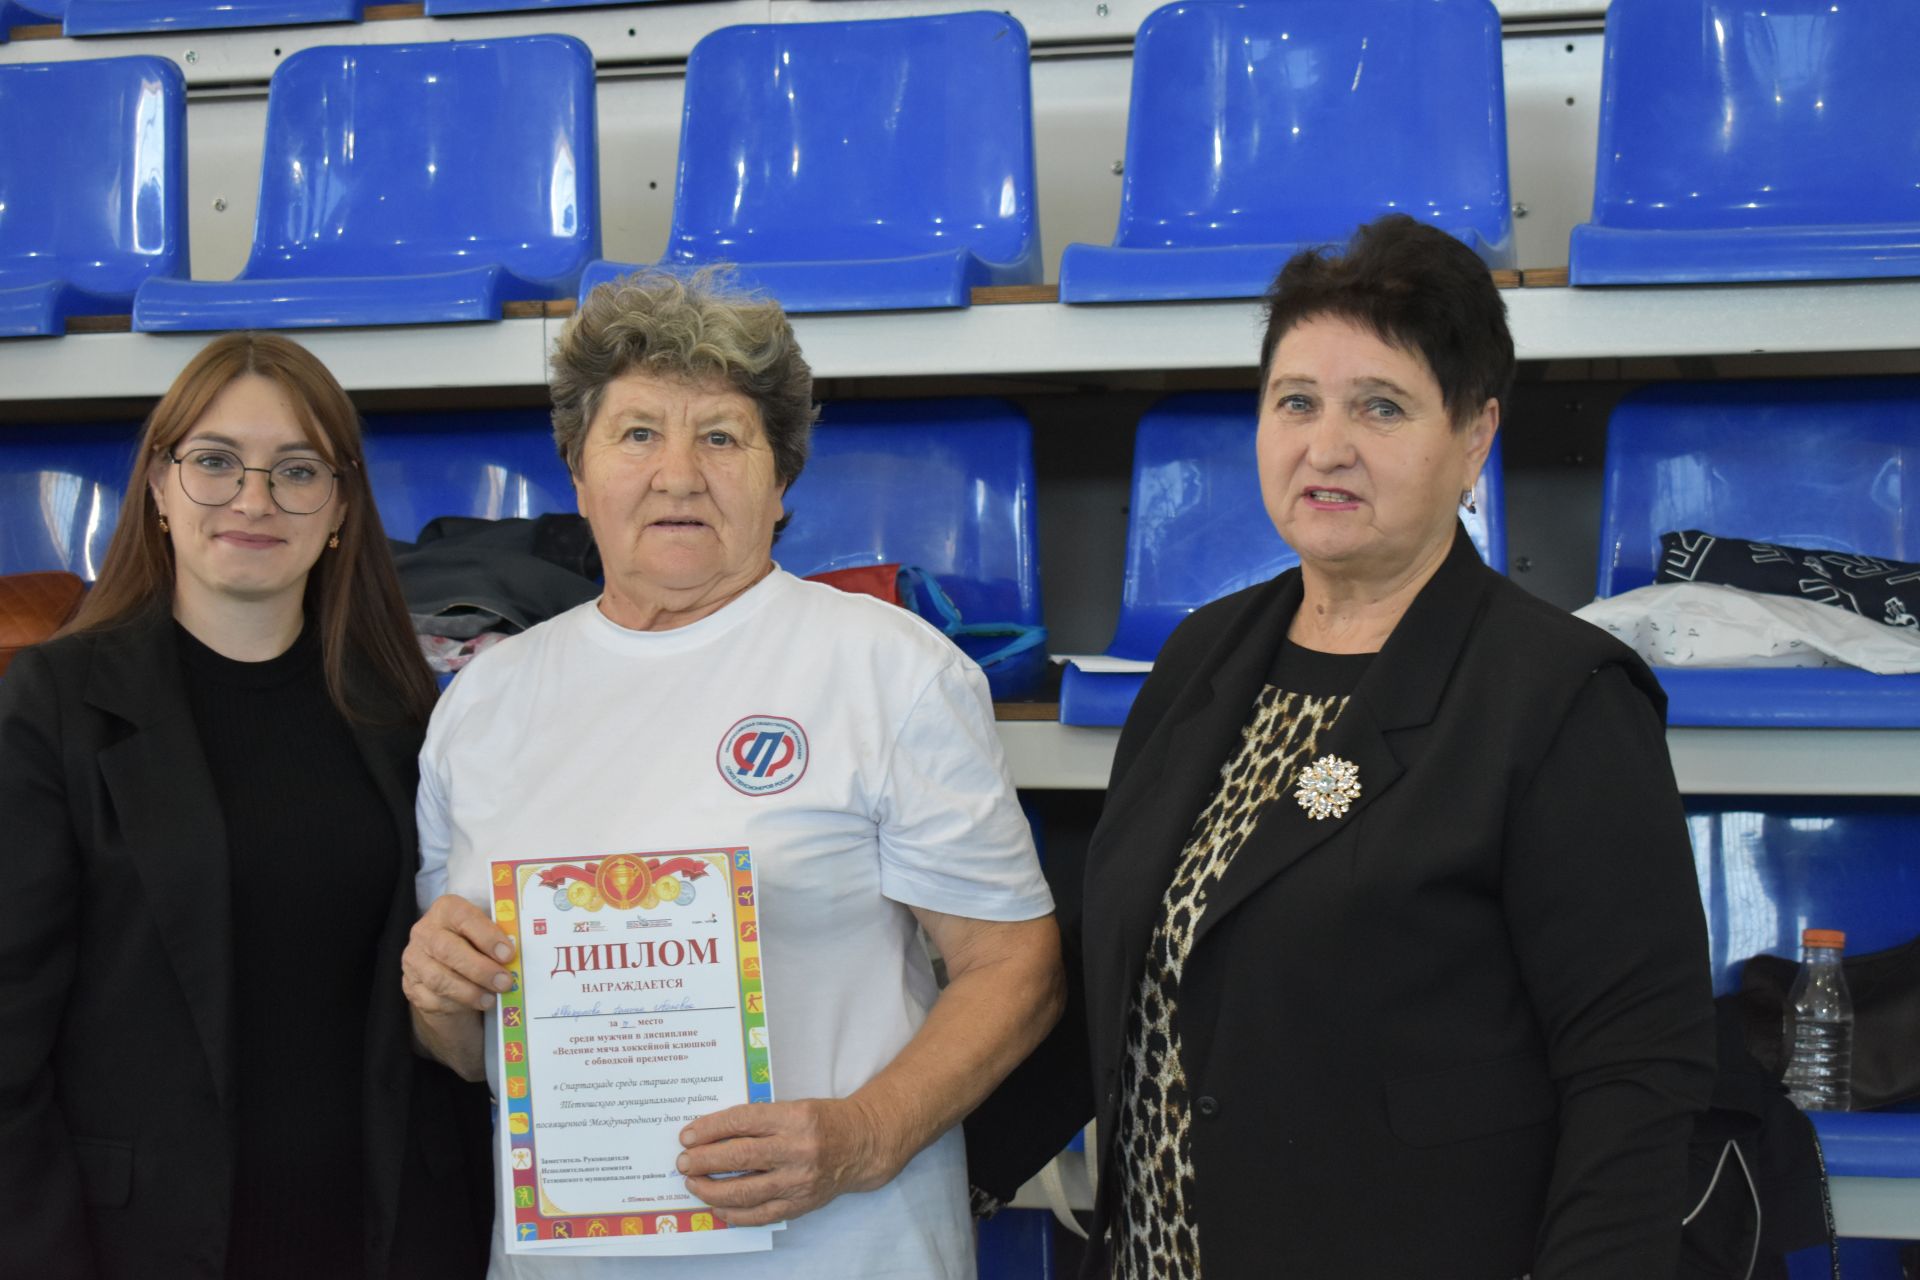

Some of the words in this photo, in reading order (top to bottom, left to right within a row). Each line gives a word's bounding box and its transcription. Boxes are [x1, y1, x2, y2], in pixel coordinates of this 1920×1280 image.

[774, 773, 795, 787] РОССИИ
[550, 937, 720, 979] ДИПЛОМ
[581, 978, 683, 993] НАГРАЖДАЕТСЯ
[638, 1018, 664, 1026] место
[569, 1035, 594, 1044] среди
[599, 1032, 633, 1043] мужчин
[644, 1029, 698, 1040] дисциплине
[553, 1046, 594, 1056] «Ведение
[622, 1041, 669, 1052] хоккейной
[673, 1039, 717, 1049] клюшкой
[592, 1054, 633, 1066] обводкой
[636, 1053, 689, 1064] предметов»
[559, 1081, 613, 1092] Спартакиаде
[616, 1079, 637, 1090] среди
[639, 1077, 679, 1088] старшего
[681, 1075, 723, 1086] поколения
[560, 1099, 615, 1110] Тетюшского
[617, 1096, 685, 1109] муниципального
[687, 1094, 719, 1105] района,
[536, 1118, 587, 1130] посвященной
[589, 1115, 663, 1128] Международному
[664, 1113, 680, 1122] дню
[541, 1157, 581, 1165] Заместитель
[583, 1155, 629, 1164] Руководителя
[541, 1166, 600, 1175] Исполнительного
[585, 1174, 641, 1183] муниципального
[642, 1172, 666, 1181] района
